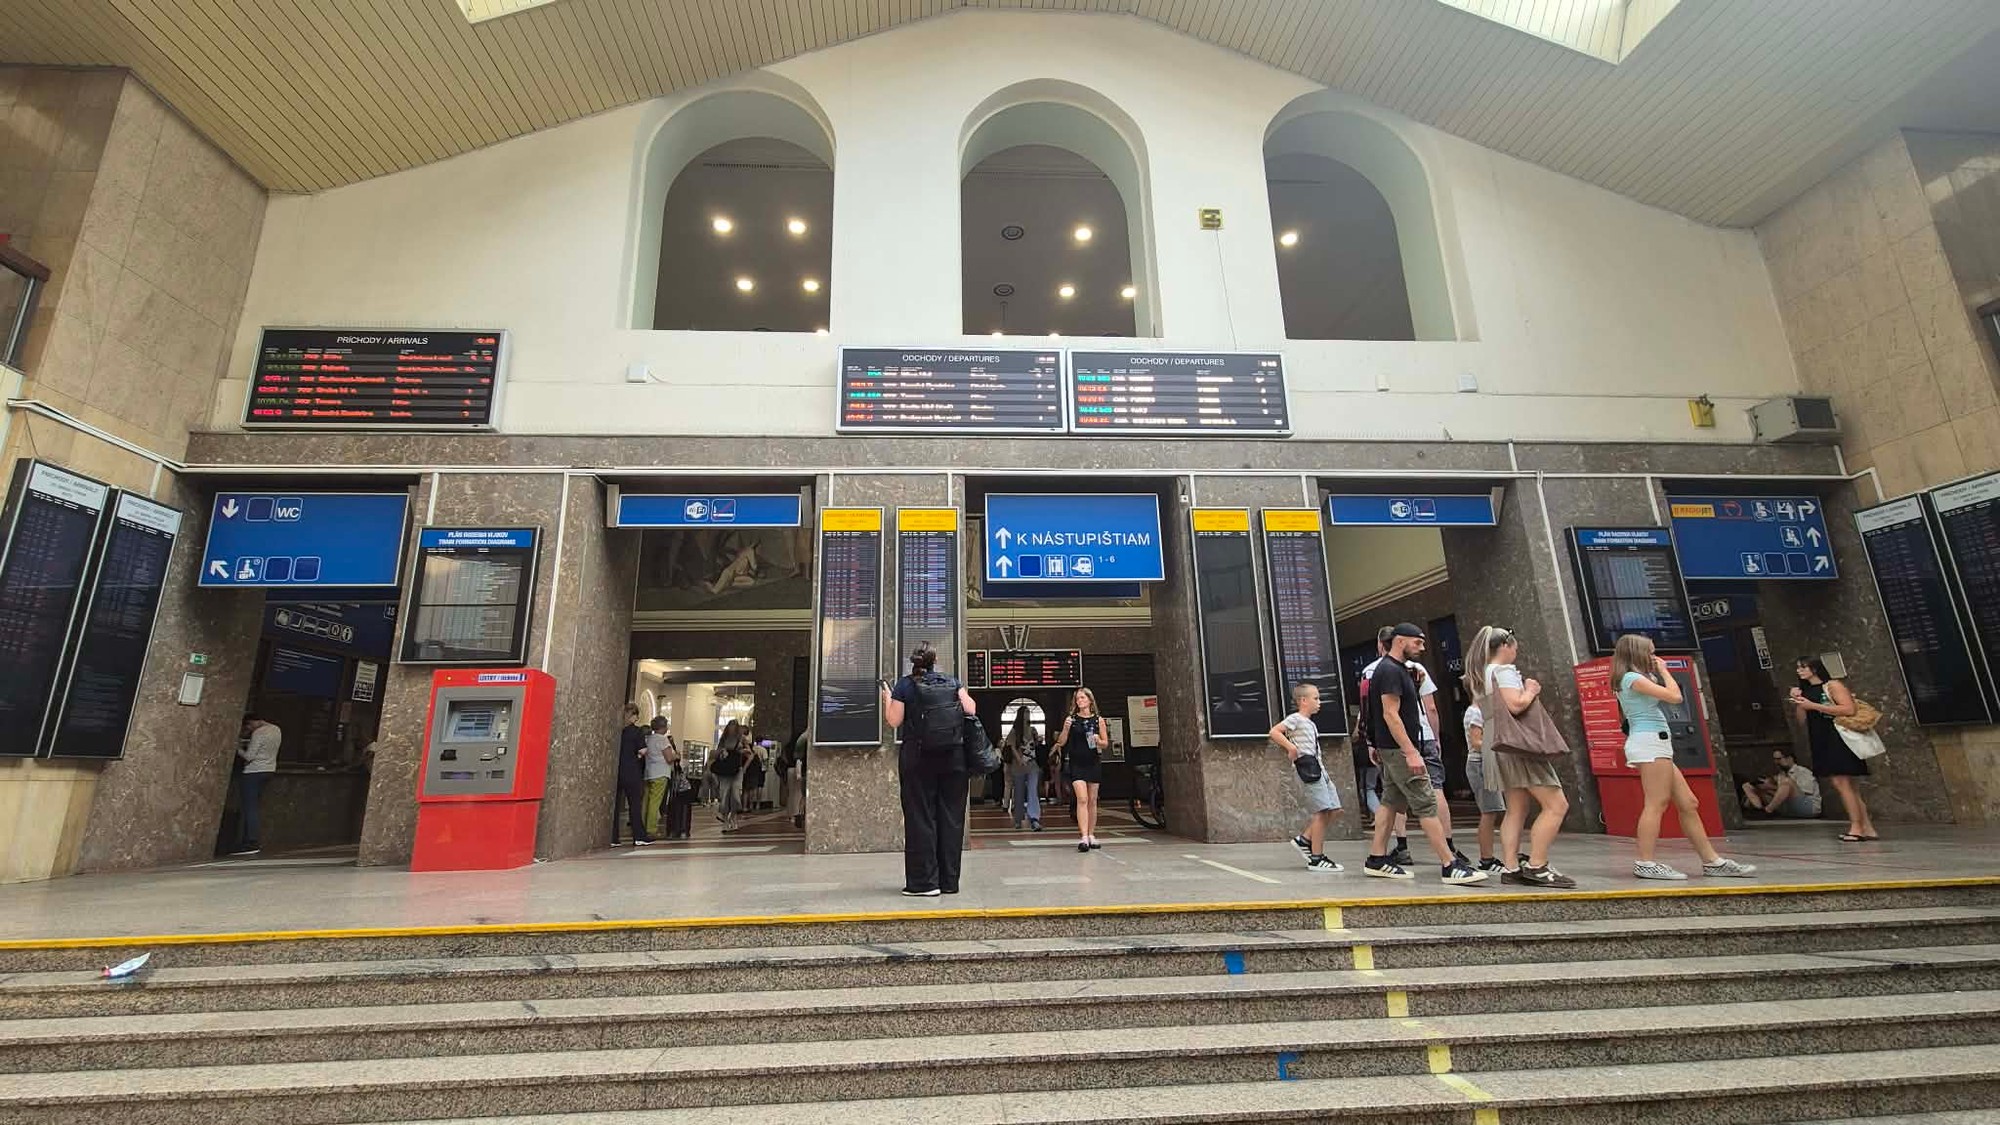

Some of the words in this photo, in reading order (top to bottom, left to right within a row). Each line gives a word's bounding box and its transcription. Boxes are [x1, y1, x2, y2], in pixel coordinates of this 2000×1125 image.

[336, 335, 382, 344] PRÍCHODY
[387, 337, 429, 345] ARRIVALS
[902, 354, 942, 362] ODCHODY
[948, 355, 1001, 363] DEPARTURES
[1130, 357, 1169, 365] ODCHODY
[1174, 358, 1225, 366] DEPARTURES
[277, 507, 301, 519] WC
[1017, 533, 1028, 546] K
[1032, 530, 1150, 546] NÁSTUPIŠTIAM
